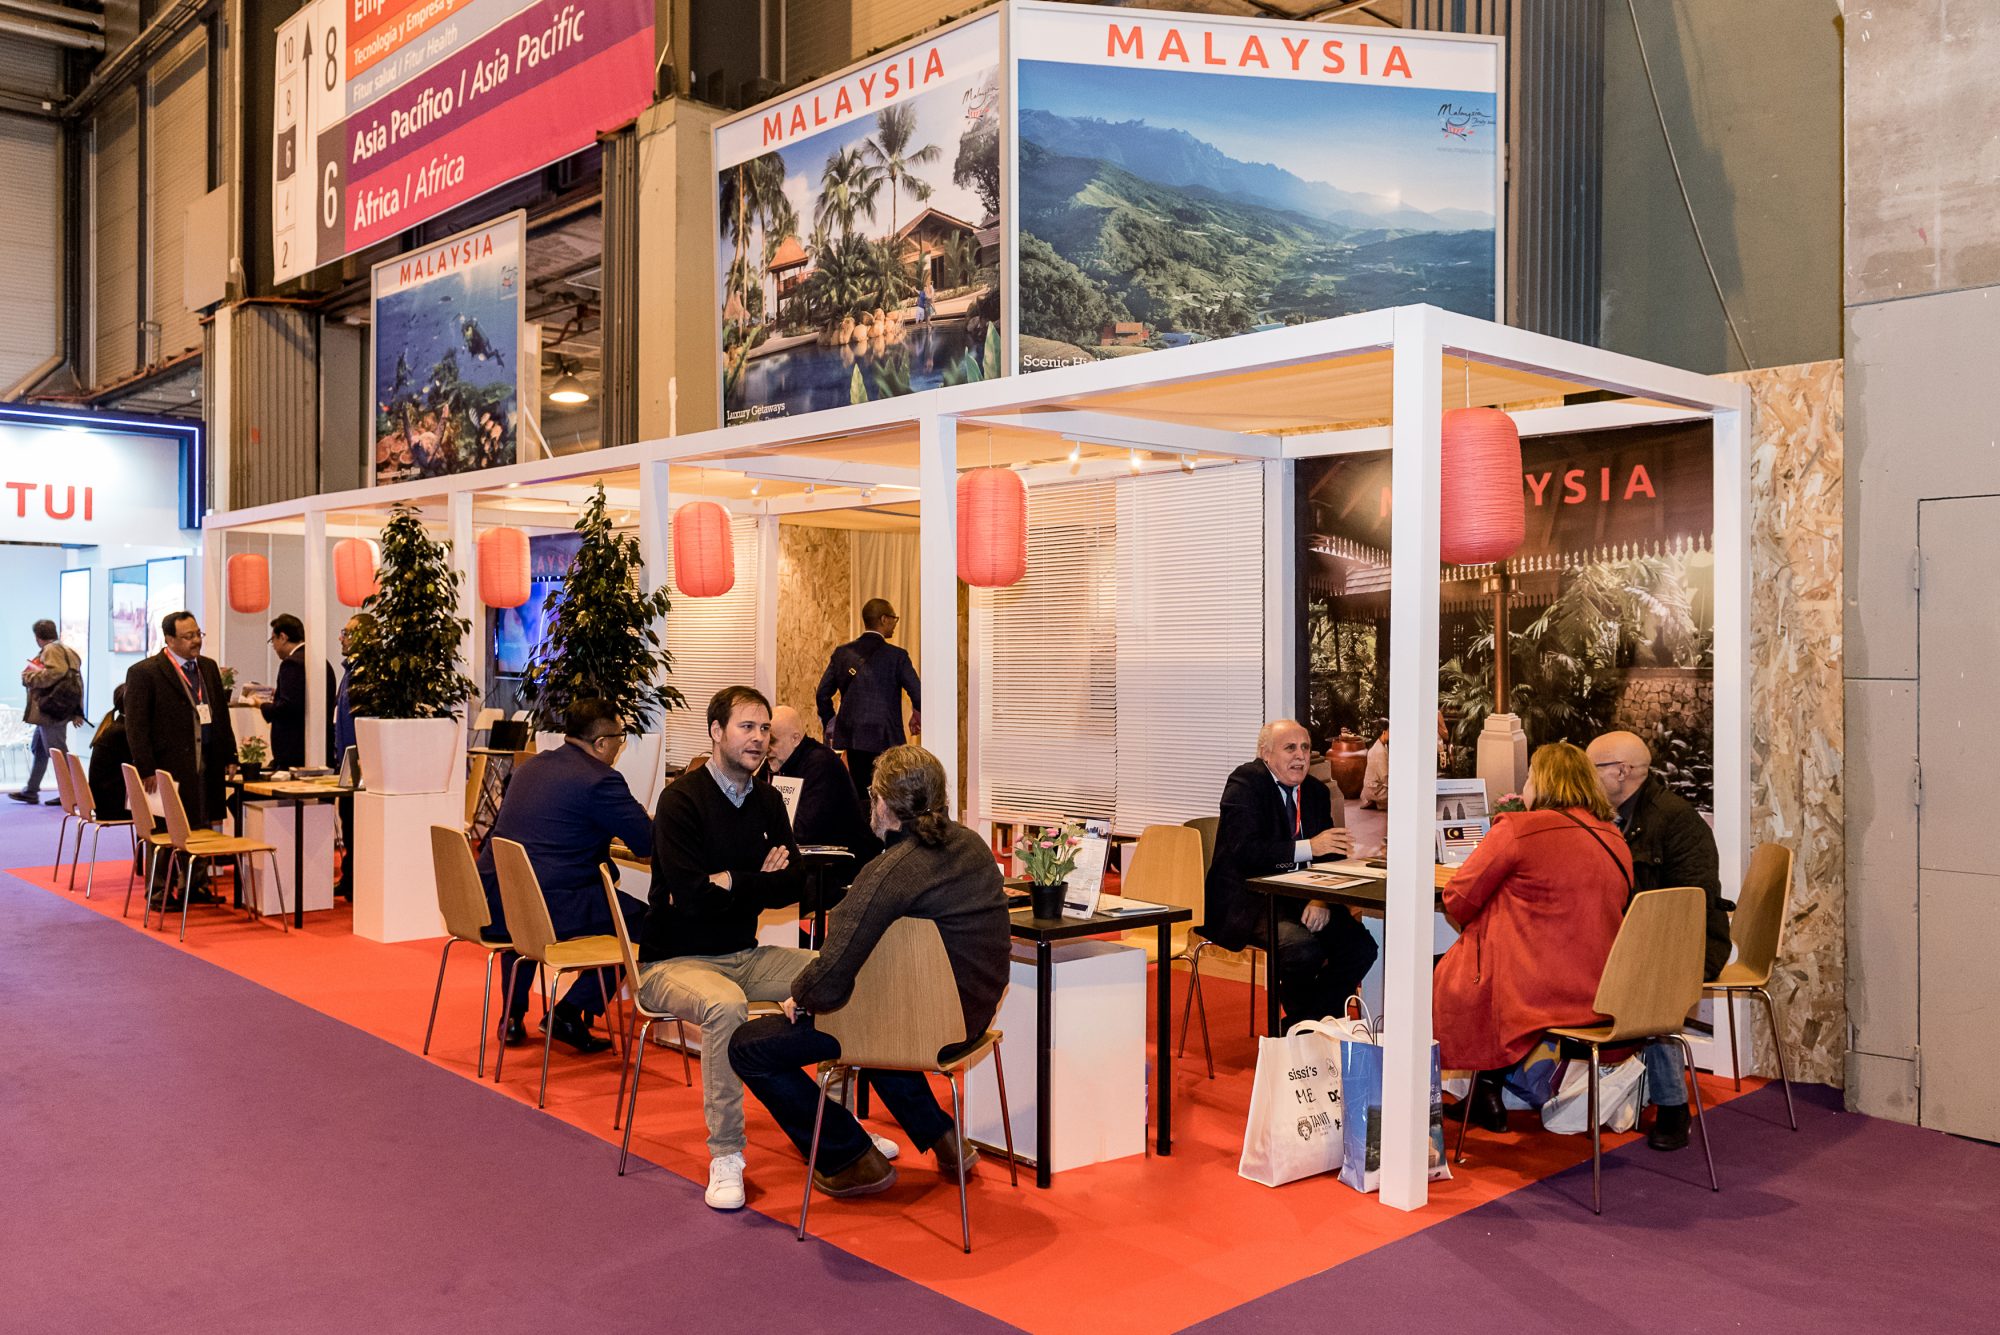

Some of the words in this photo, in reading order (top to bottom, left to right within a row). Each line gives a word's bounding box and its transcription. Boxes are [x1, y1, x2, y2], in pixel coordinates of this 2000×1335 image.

[399, 22, 405, 42] y
[284, 36, 293, 66] 10
[326, 26, 337, 92] 8
[353, 80, 373, 103] Fitur
[375, 61, 397, 90] salud
[404, 46, 425, 72] Fitur
[427, 22, 458, 58] Health
[1107, 24, 1412, 79] MALAYSIA
[352, 120, 387, 164] Asia
[391, 87, 453, 144] Pacífico
[469, 48, 508, 100] Asia
[515, 5, 585, 74] Pacific
[763, 47, 944, 146] MALAYSIA
[287, 89, 291, 116] 8
[285, 140, 292, 168] 6
[323, 161, 338, 229] 6
[353, 187, 399, 231] África
[414, 153, 465, 203] Africa
[282, 241, 289, 268] 2
[400, 234, 493, 286] MALAYSIA
[1023, 355, 1069, 368] Scenic
[727, 408, 751, 420] Luxury
[751, 402, 786, 416] Getaways
[6, 482, 93, 521] TUI
[1295, 1088, 1316, 1104] ME
[1309, 1112, 1331, 1128] TANIT
